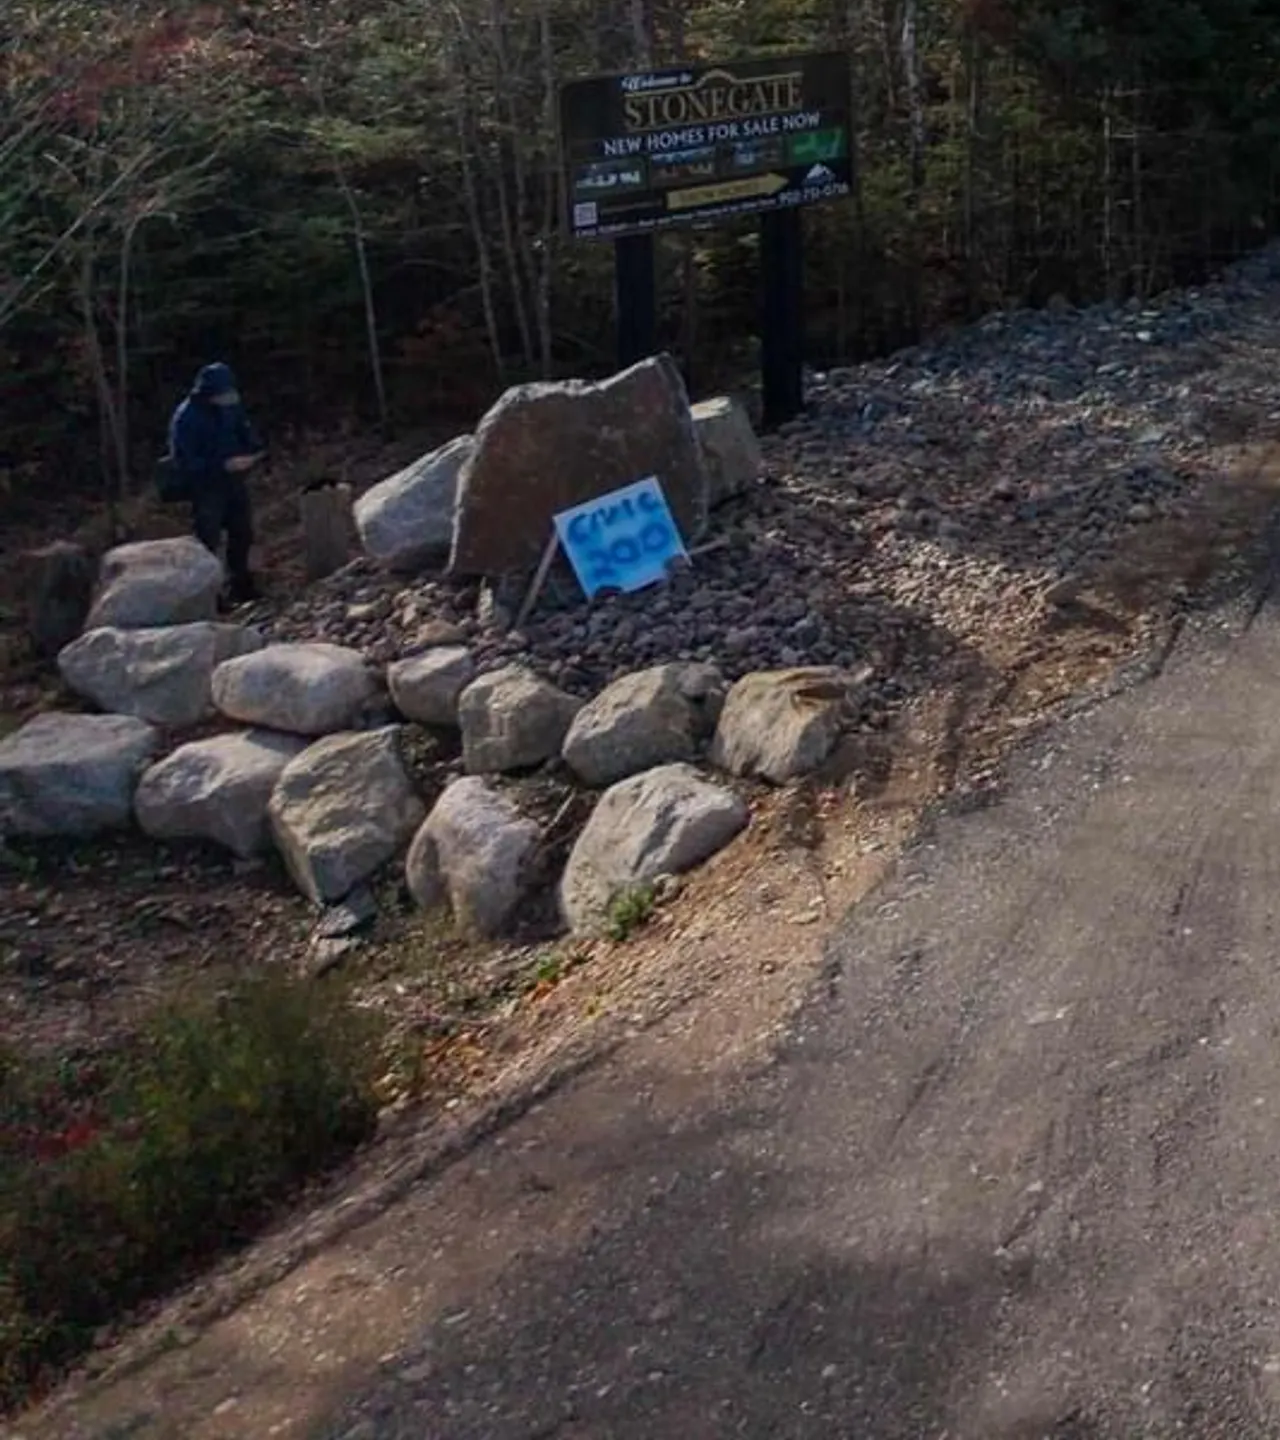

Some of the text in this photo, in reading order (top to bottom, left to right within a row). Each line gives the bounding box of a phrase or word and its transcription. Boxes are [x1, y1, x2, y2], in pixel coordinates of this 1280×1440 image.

[623, 76, 804, 129] STONEGATE
[604, 112, 820, 155] NEW HOMES FOR SALE NOW
[568, 491, 661, 545] CIVIC
[588, 521, 671, 581] 200
